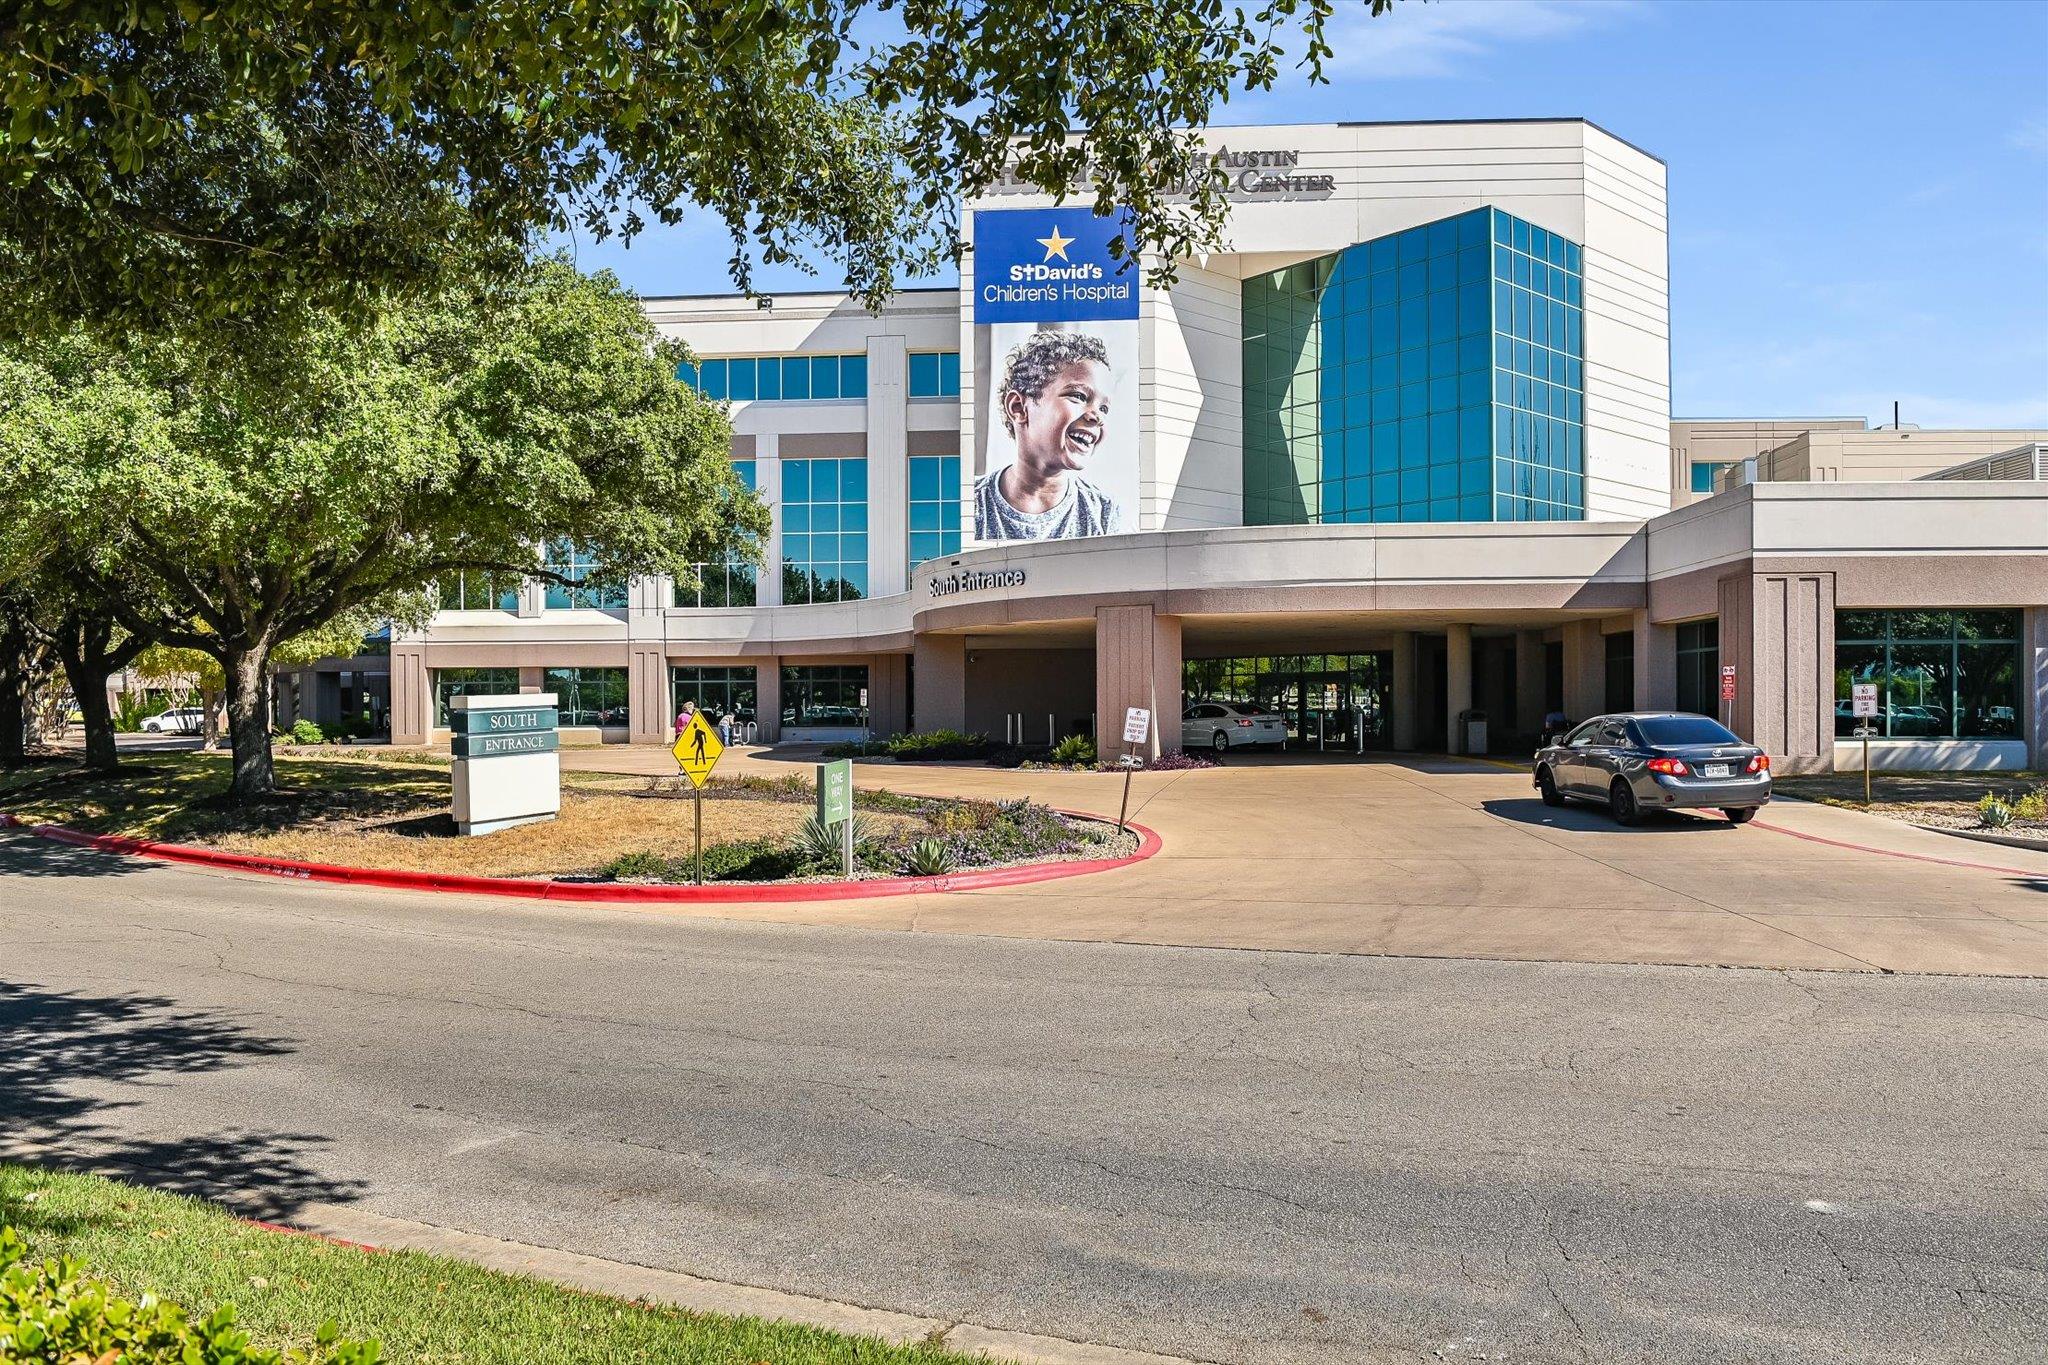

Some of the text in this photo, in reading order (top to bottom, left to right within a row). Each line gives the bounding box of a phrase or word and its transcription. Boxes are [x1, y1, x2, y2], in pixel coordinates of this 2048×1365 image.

[1213, 145, 1299, 168] AUSTIN
[1238, 170, 1337, 193] CENTER
[984, 282, 1130, 304] Children's Hospital
[928, 569, 1026, 598] South Entrance
[490, 713, 538, 730] SOUTH
[485, 736, 545, 752] ENTRANCE
[831, 772, 844, 785] ONE
